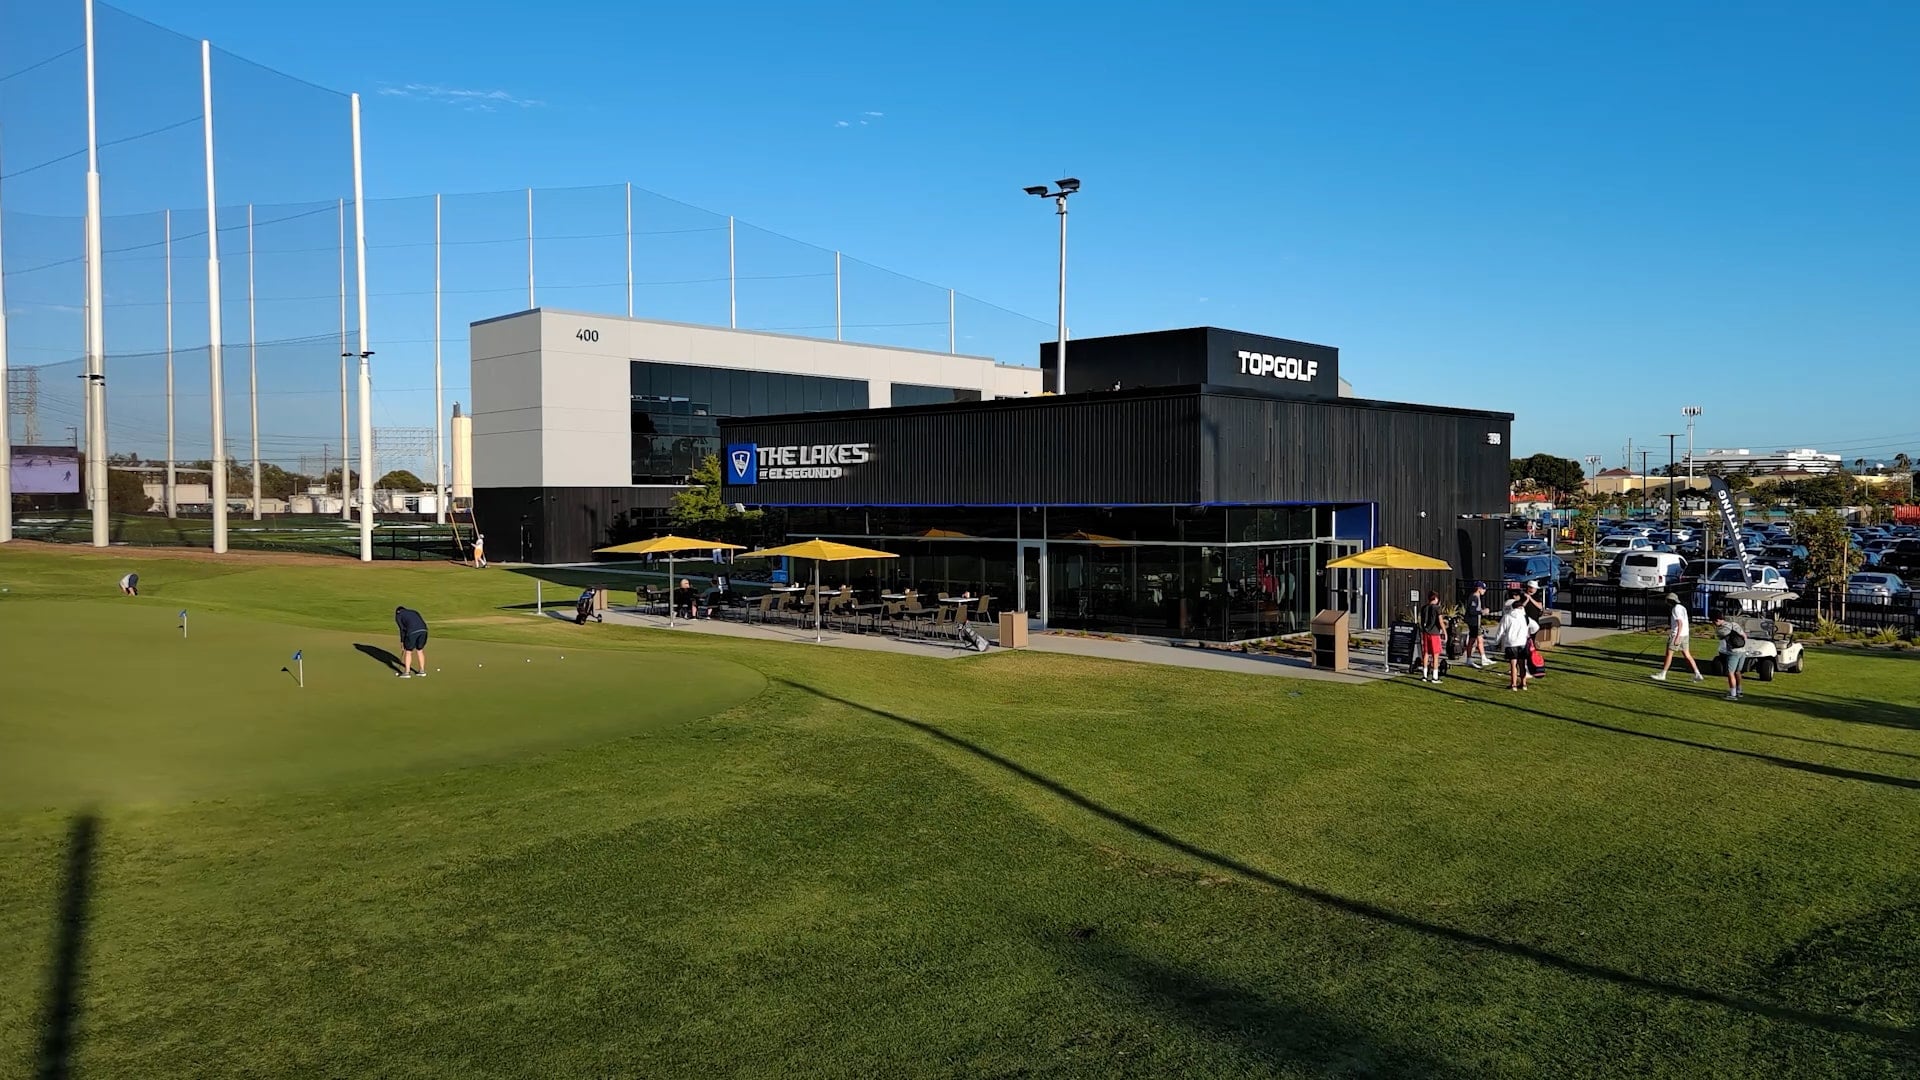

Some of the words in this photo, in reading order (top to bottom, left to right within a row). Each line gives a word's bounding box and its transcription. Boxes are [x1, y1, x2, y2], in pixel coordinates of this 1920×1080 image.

[575, 328, 599, 342] 400
[1238, 350, 1318, 382] TOPGOLF
[757, 446, 798, 466] THE
[799, 443, 869, 465] LAKES
[769, 468, 785, 480] EL
[785, 467, 843, 480] SEGUNDO
[1717, 489, 1742, 541] FITTING
